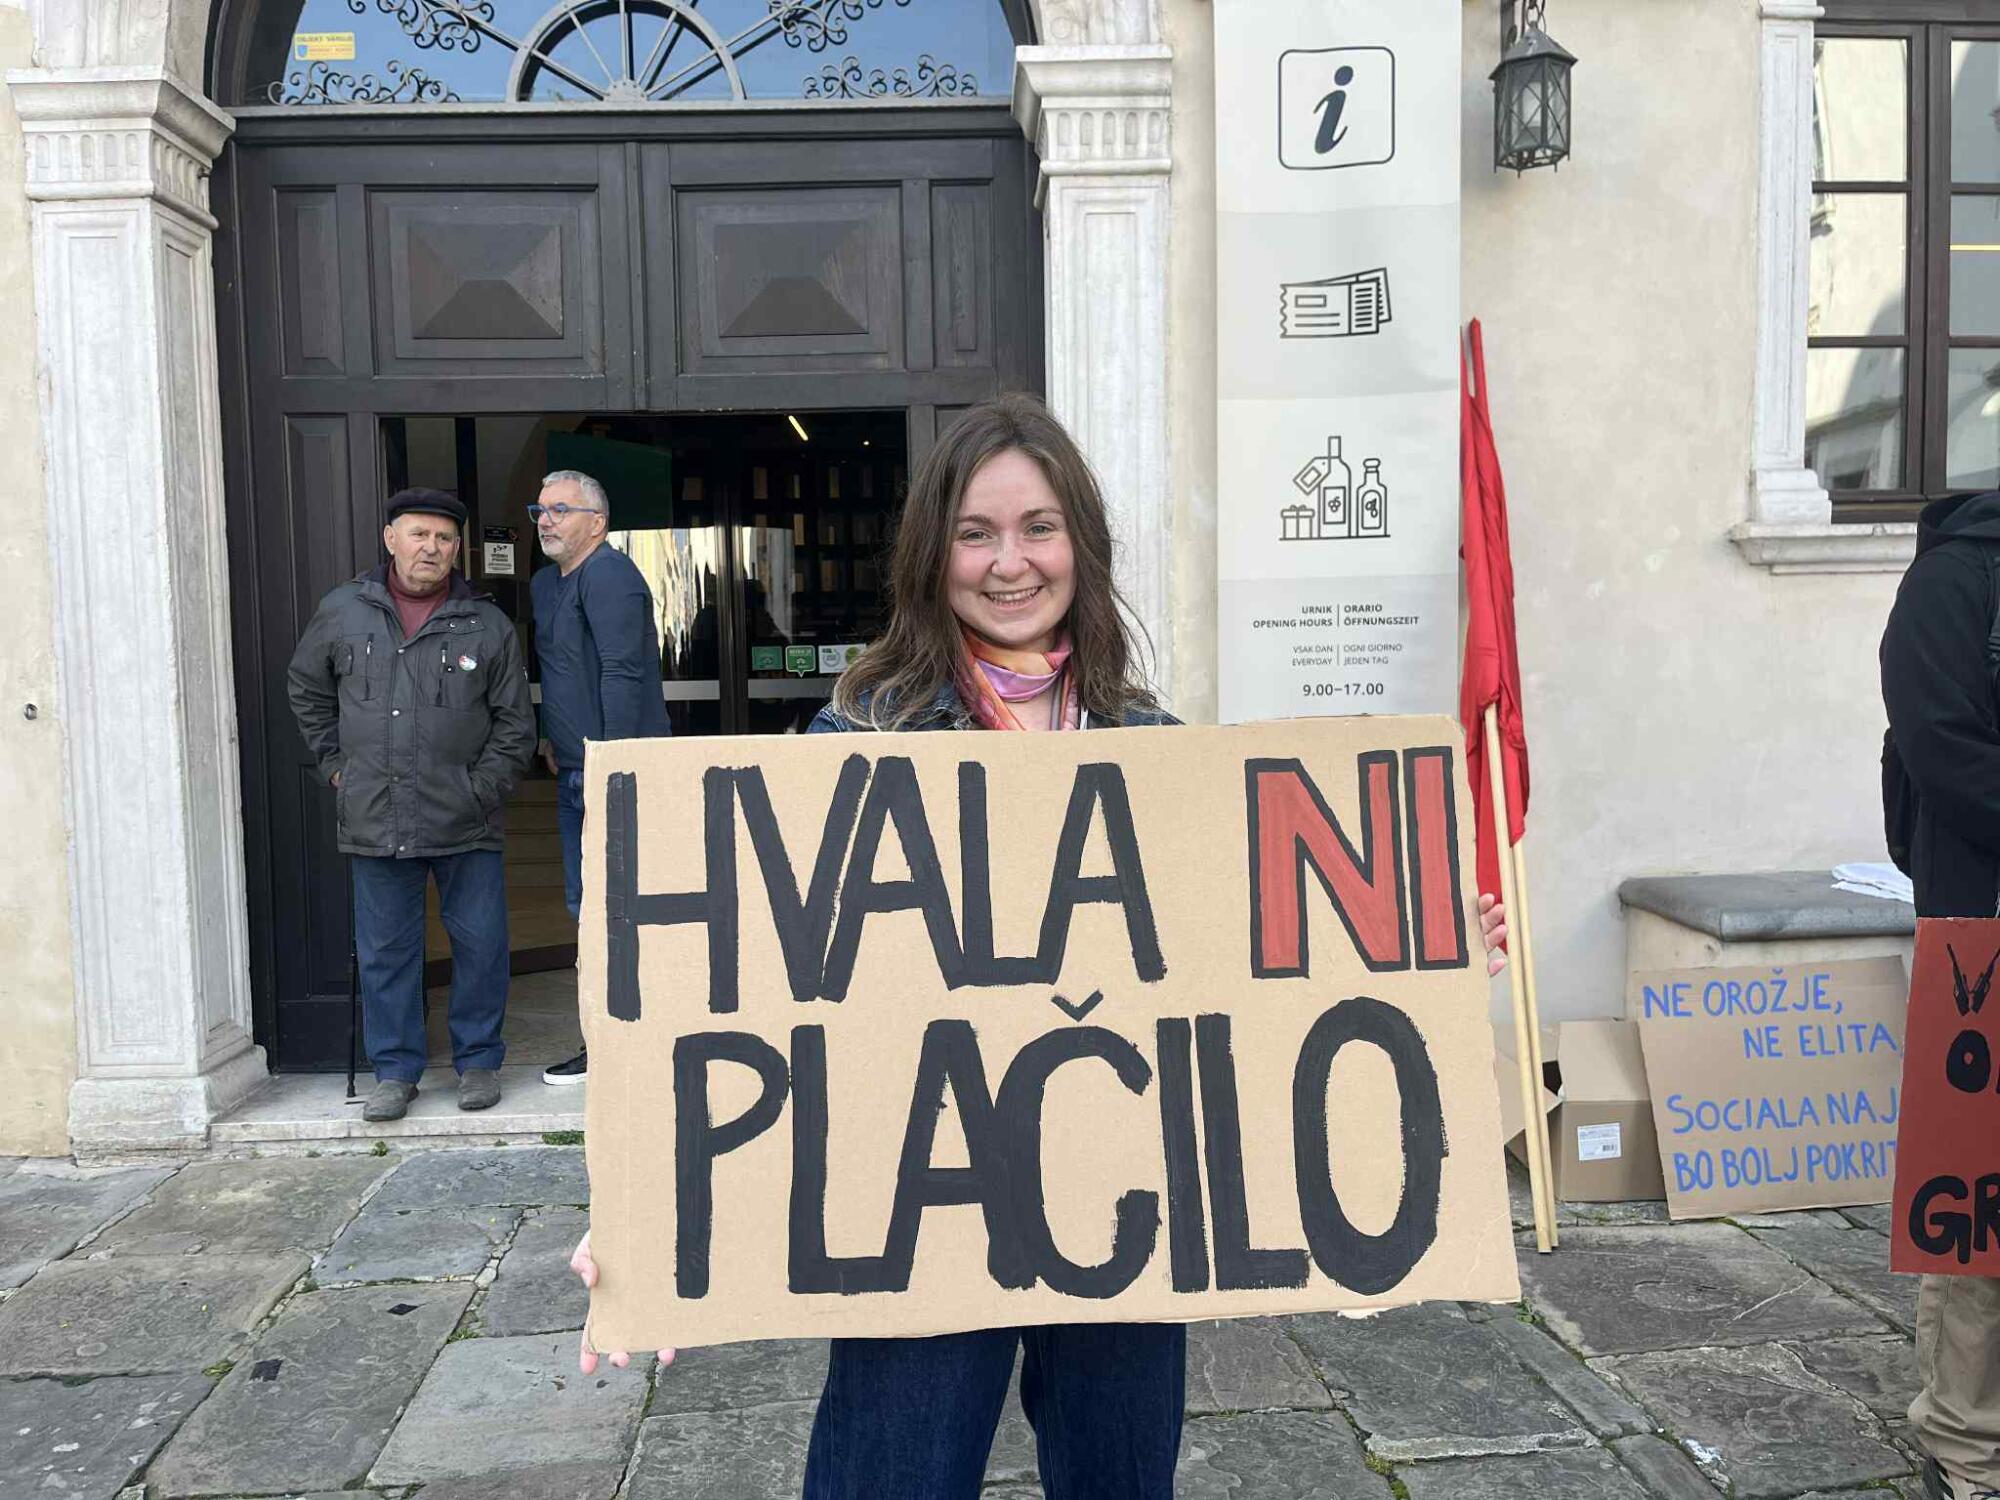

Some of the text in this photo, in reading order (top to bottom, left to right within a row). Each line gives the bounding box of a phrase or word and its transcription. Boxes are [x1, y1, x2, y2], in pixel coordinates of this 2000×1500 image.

[1301, 605, 1333, 614] URNIK
[1344, 604, 1383, 613] ORARIO
[1253, 618, 1333, 628] OPENING HOURS
[1344, 616, 1420, 626] ÖFFNUNGSZEIT
[1293, 645, 1333, 653] VSAK DAN
[1343, 643, 1403, 652] OGNI GIORNO
[1292, 658, 1333, 666] EVERYDAY
[1343, 656, 1389, 665] JEDEN TAG
[606, 746, 1470, 1022] HVALA NI
[1643, 968, 1843, 1018] NE OROŽJE,
[1743, 1026, 1784, 1059] NE
[1666, 1087, 1899, 1134] SOCIALA NAJ
[673, 990, 1449, 1300] PLAČILO
[1674, 1150, 1715, 1192] BO
[1721, 1146, 1800, 1189] BOLJ
